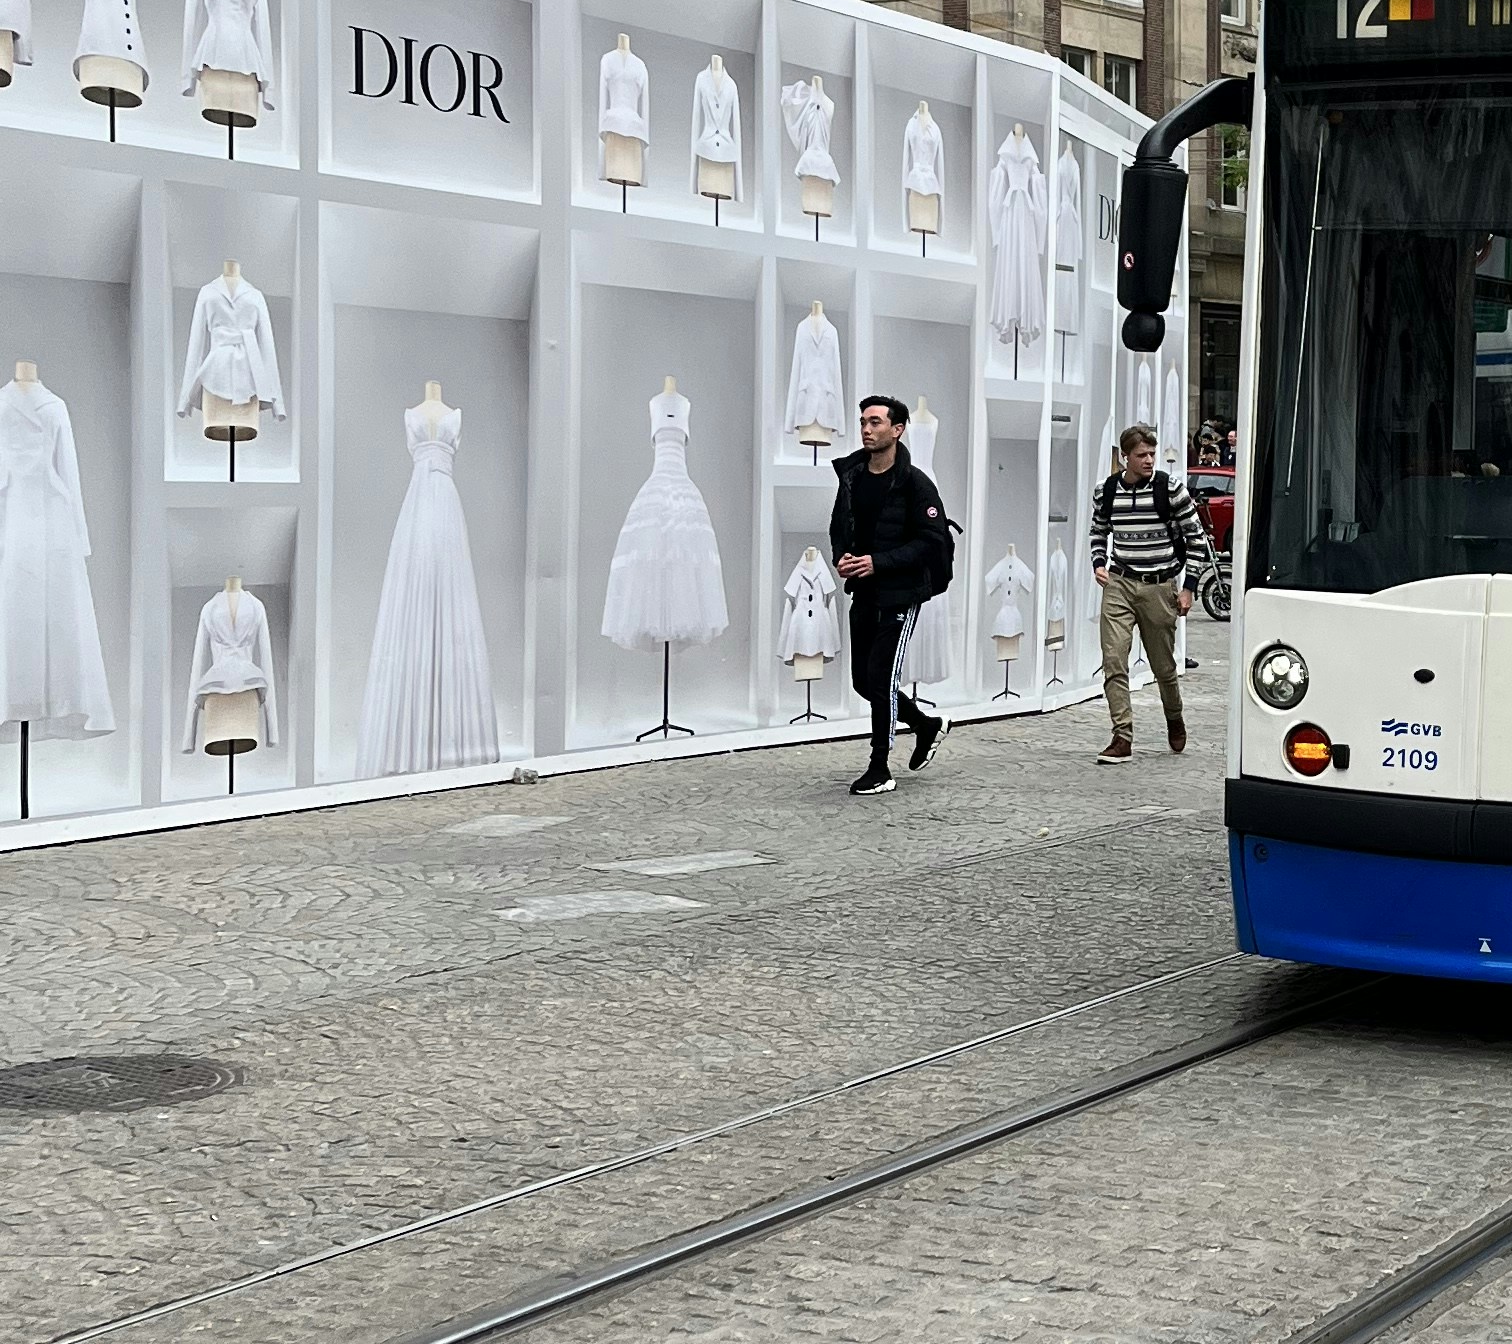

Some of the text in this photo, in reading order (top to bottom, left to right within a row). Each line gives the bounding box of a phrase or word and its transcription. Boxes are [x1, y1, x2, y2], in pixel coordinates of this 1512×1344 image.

[348, 25, 511, 124] DIOR
[1099, 193, 1121, 244] DI
[1410, 723, 1442, 737] GVB
[1382, 747, 1438, 771] 2109
